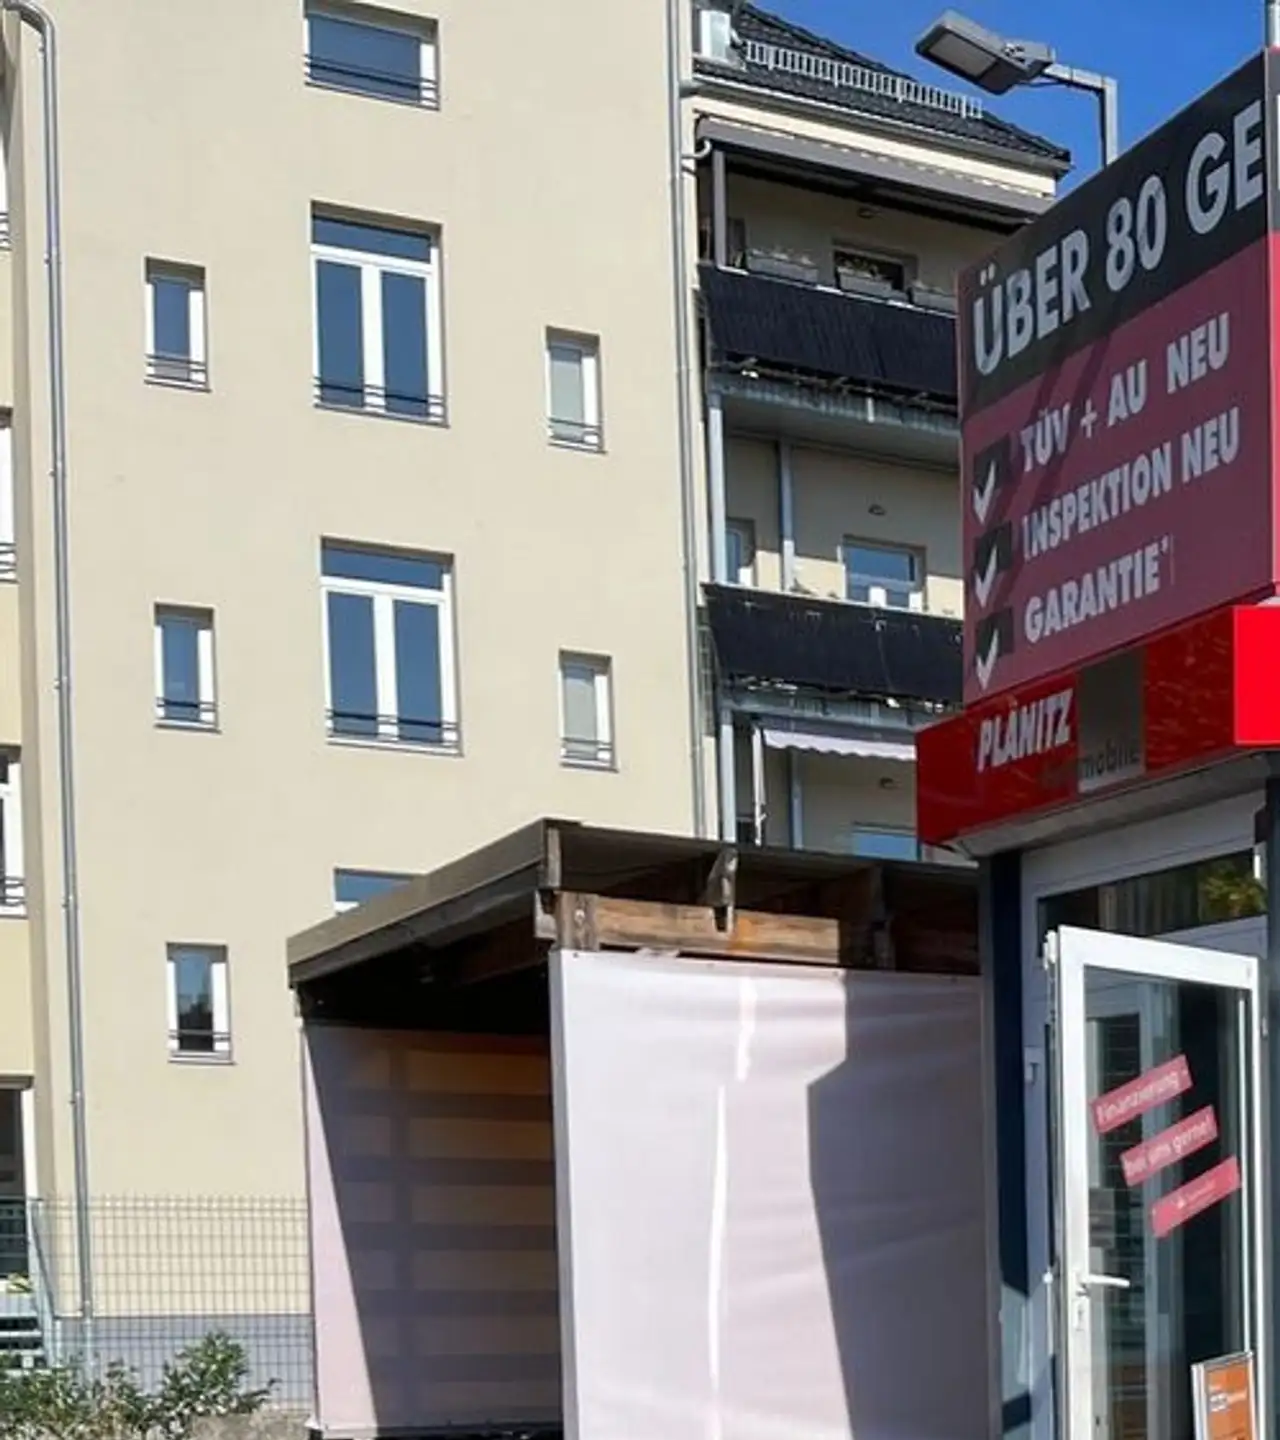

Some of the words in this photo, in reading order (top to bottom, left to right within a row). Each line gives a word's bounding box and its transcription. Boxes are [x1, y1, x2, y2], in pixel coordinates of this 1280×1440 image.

[974, 263, 1091, 376] ÜBER
[1105, 175, 1167, 292] 80
[1021, 402, 1071, 473] TÜV
[1108, 358, 1147, 427] AU
[1166, 312, 1229, 394] NEU
[1022, 441, 1172, 562] INSPEKTION
[1182, 406, 1239, 484] NEU
